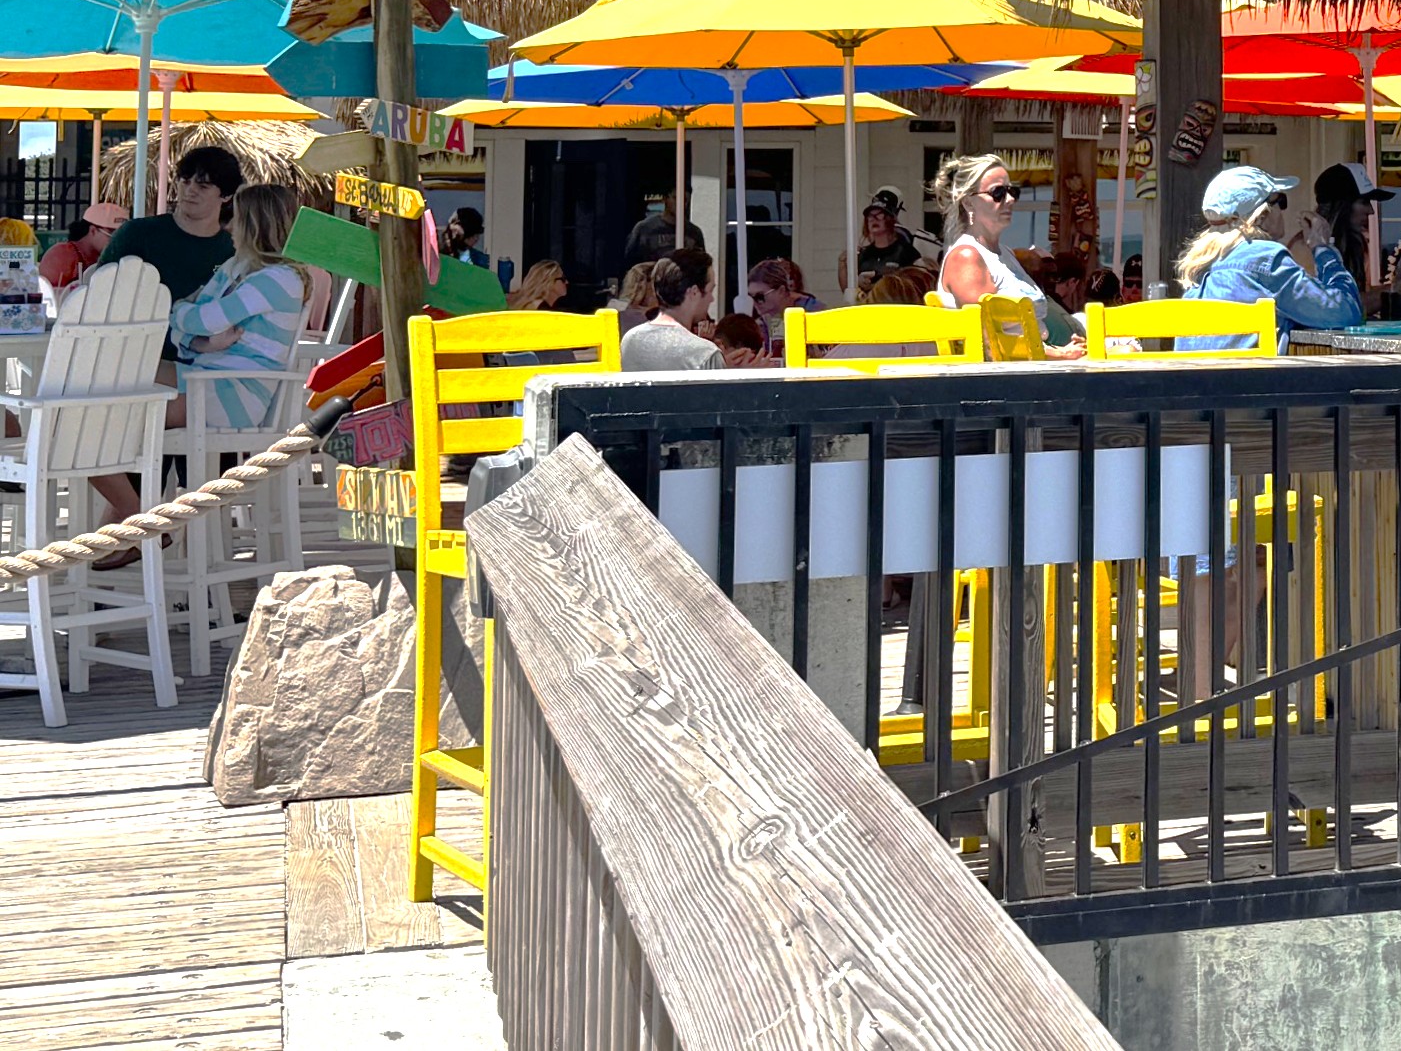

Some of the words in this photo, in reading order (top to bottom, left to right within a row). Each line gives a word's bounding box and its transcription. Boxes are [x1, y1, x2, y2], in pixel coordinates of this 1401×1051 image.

[371, 100, 465, 153] ARUBA
[338, 401, 414, 466] TON
[385, 515, 405, 547] MI
